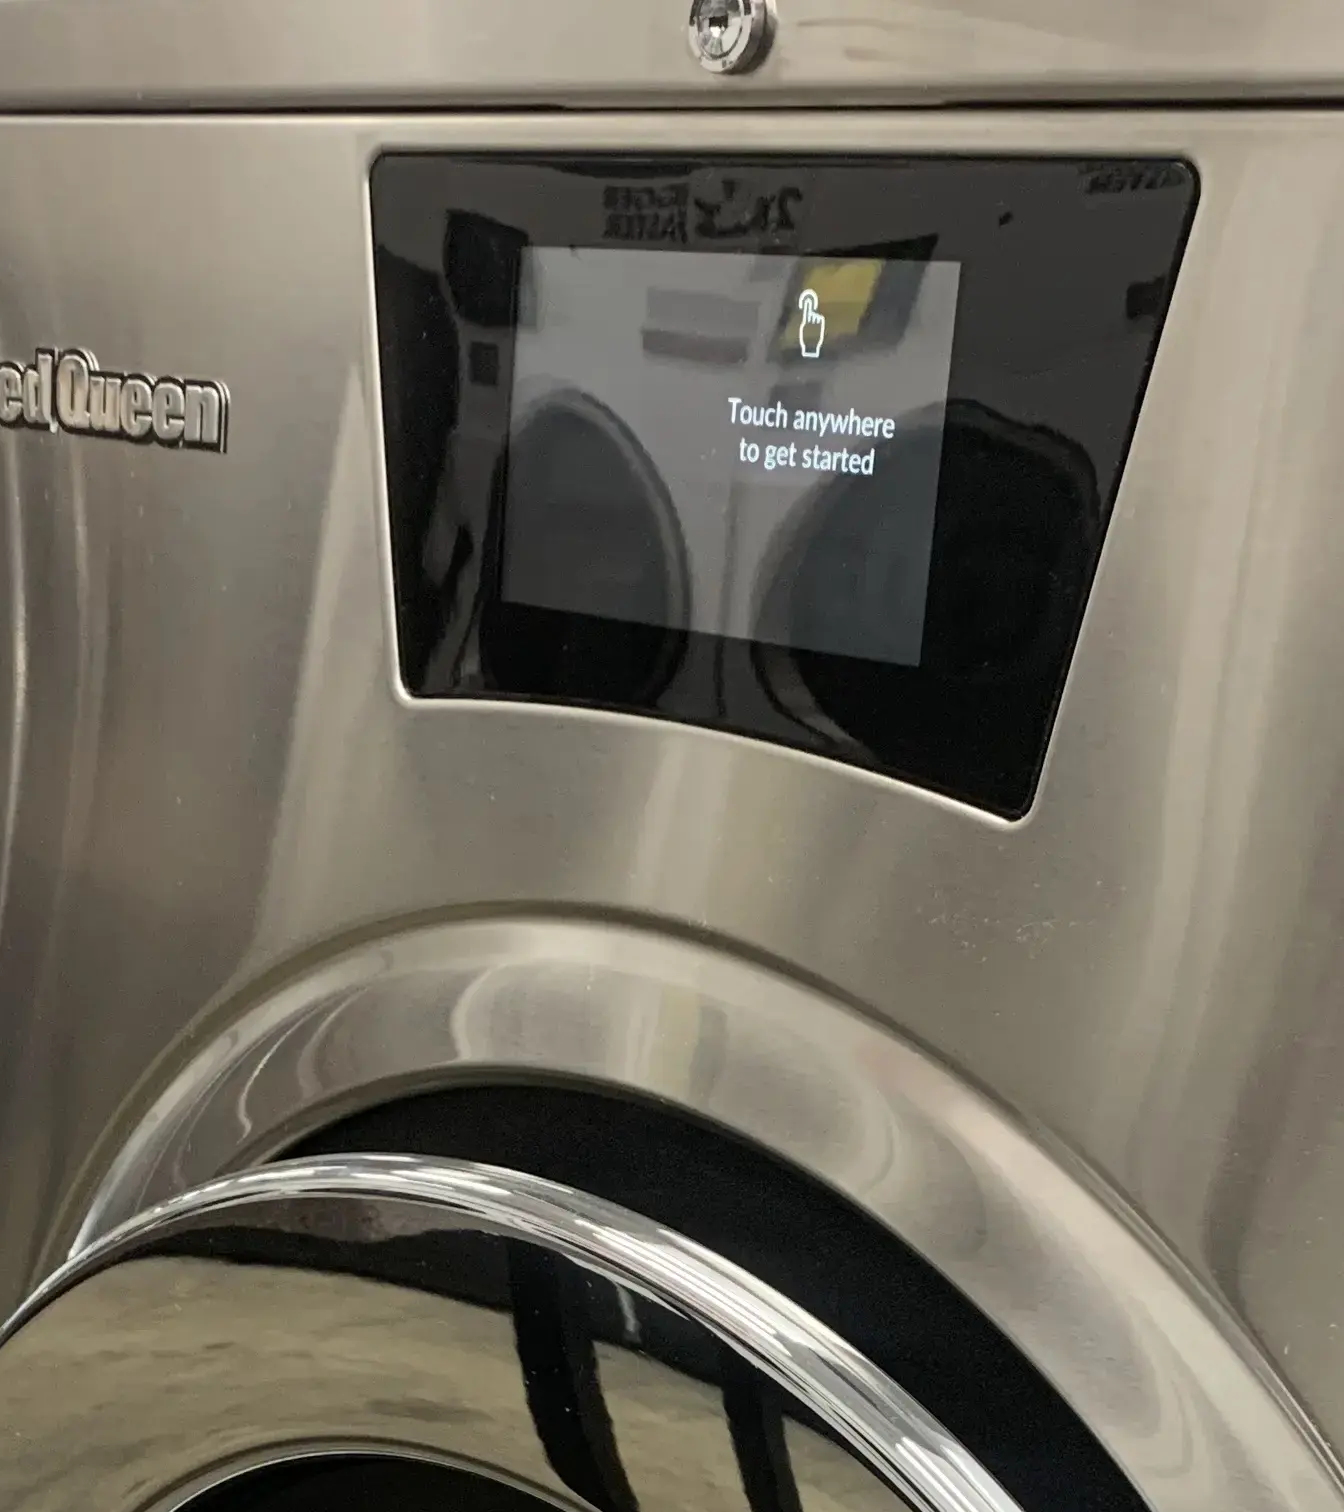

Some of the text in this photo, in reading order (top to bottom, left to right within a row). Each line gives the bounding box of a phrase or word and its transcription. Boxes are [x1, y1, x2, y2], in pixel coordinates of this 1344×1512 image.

[56, 348, 231, 455] Queen
[727, 396, 896, 440] Touch anywhere
[739, 437, 876, 477] to get started
